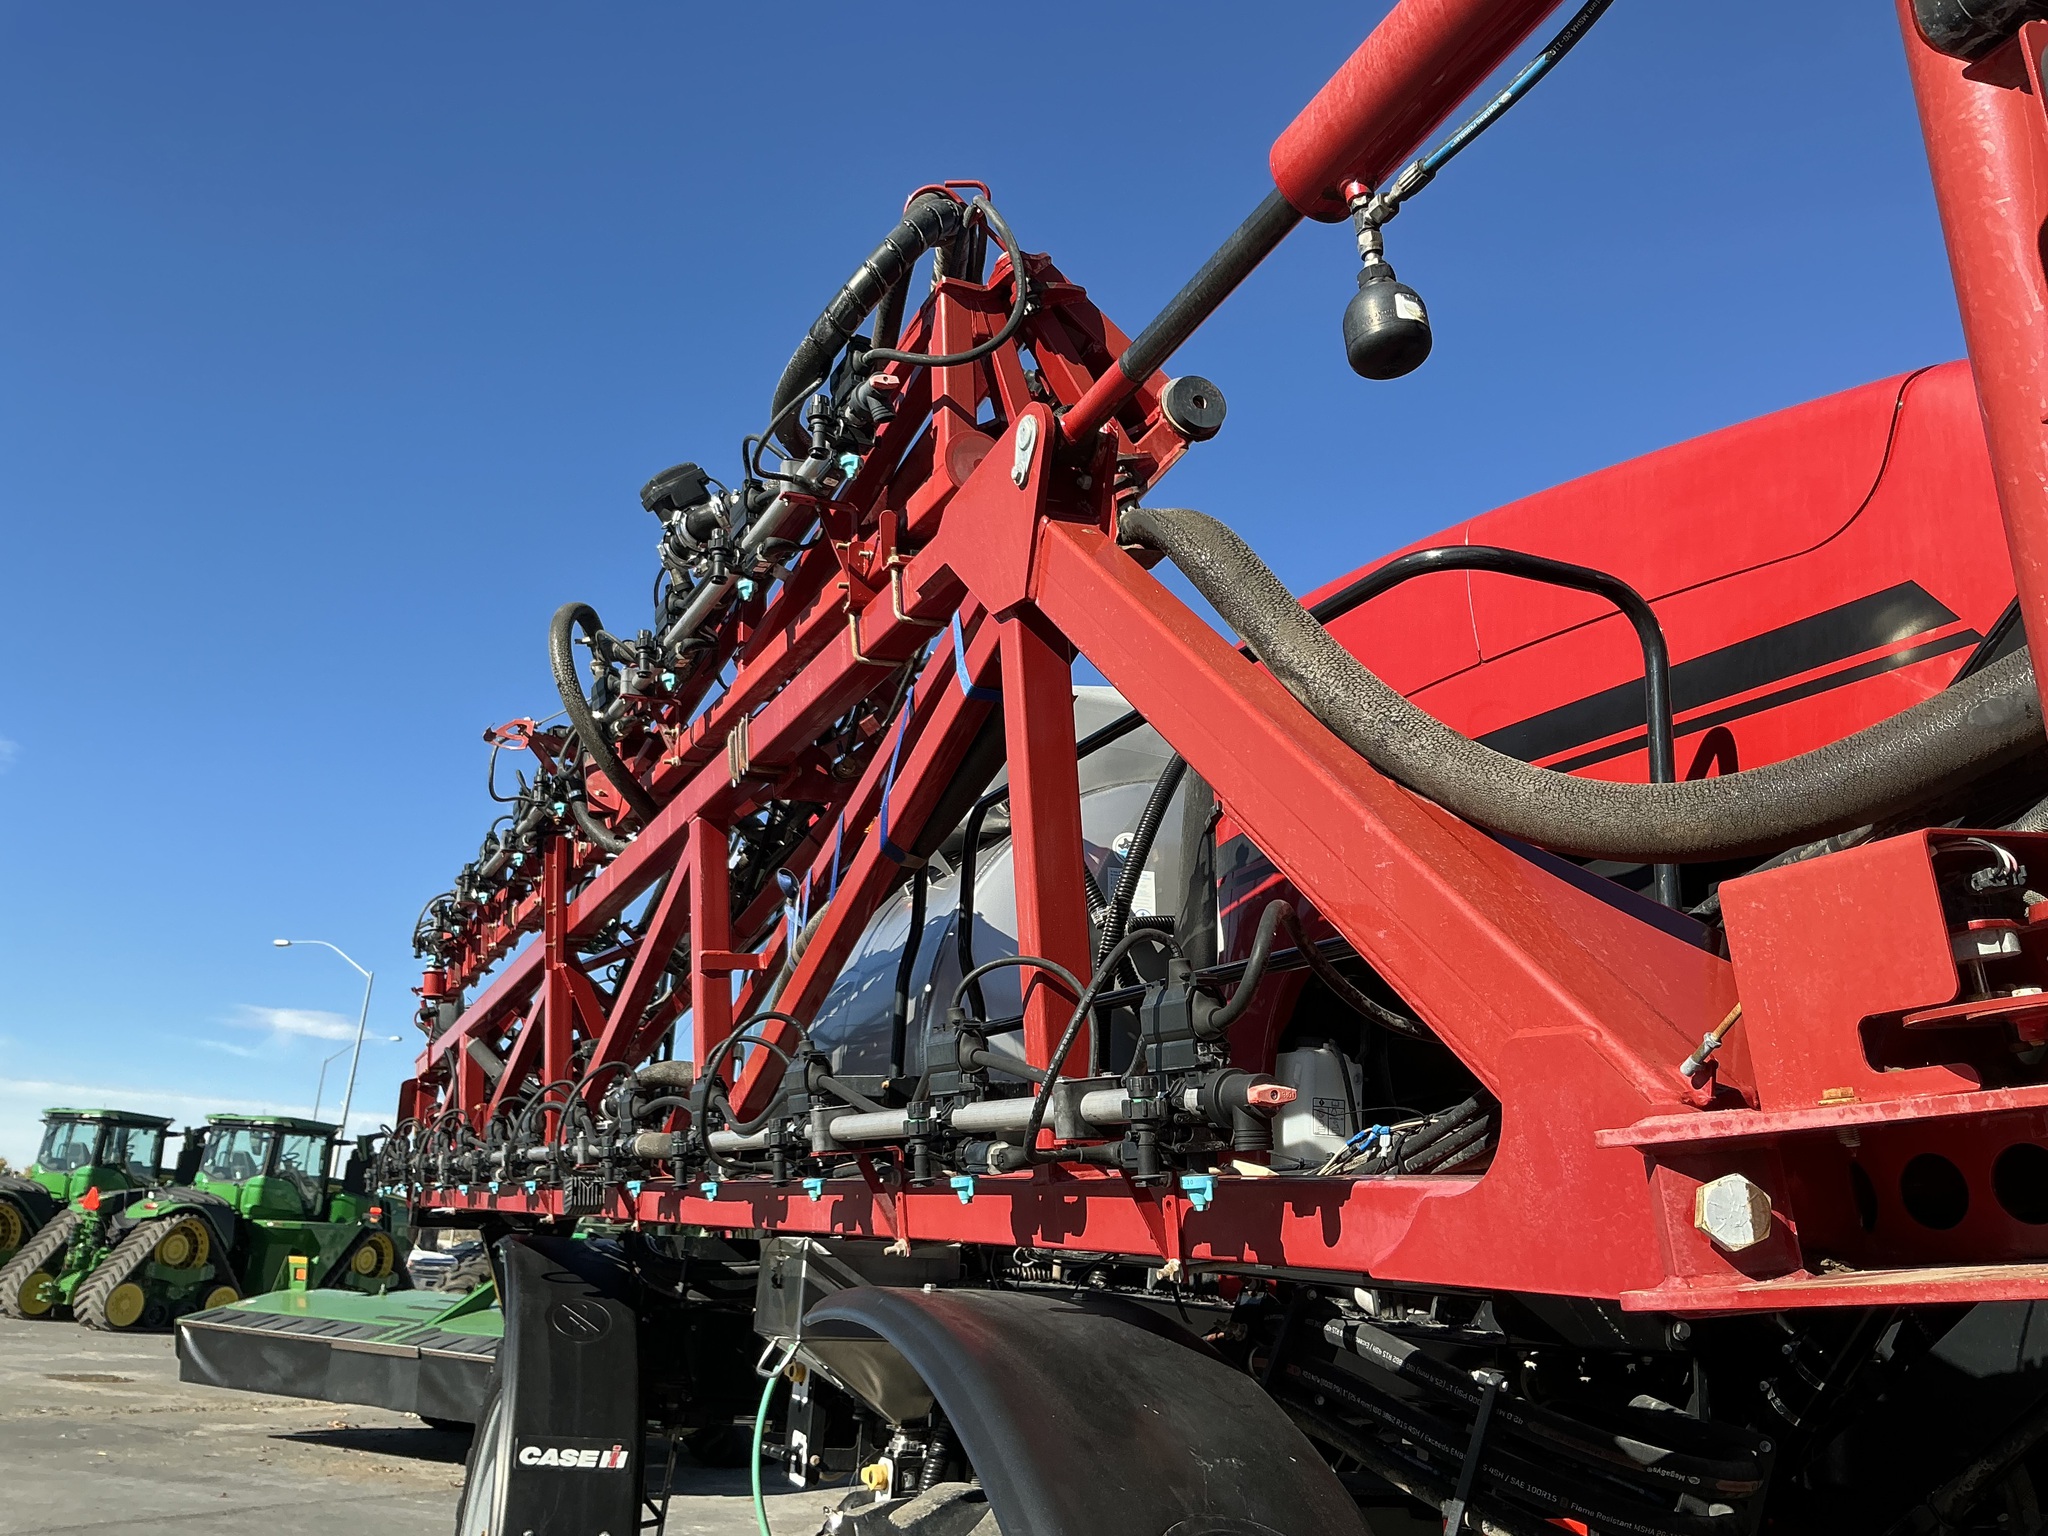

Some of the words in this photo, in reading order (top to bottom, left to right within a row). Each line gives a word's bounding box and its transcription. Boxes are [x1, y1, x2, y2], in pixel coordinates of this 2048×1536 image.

[1571, 13, 1588, 32] MSHA
[1396, 1418, 1408, 1430] R15
[1424, 1435, 1450, 1452] Exceeds
[519, 1446, 600, 1468] CASE
[1510, 1477, 1525, 1488] SAE
[1526, 1485, 1558, 1502] 100R15
[1571, 1503, 1595, 1516] Flame
[1596, 1512, 1633, 1529] Resistant
